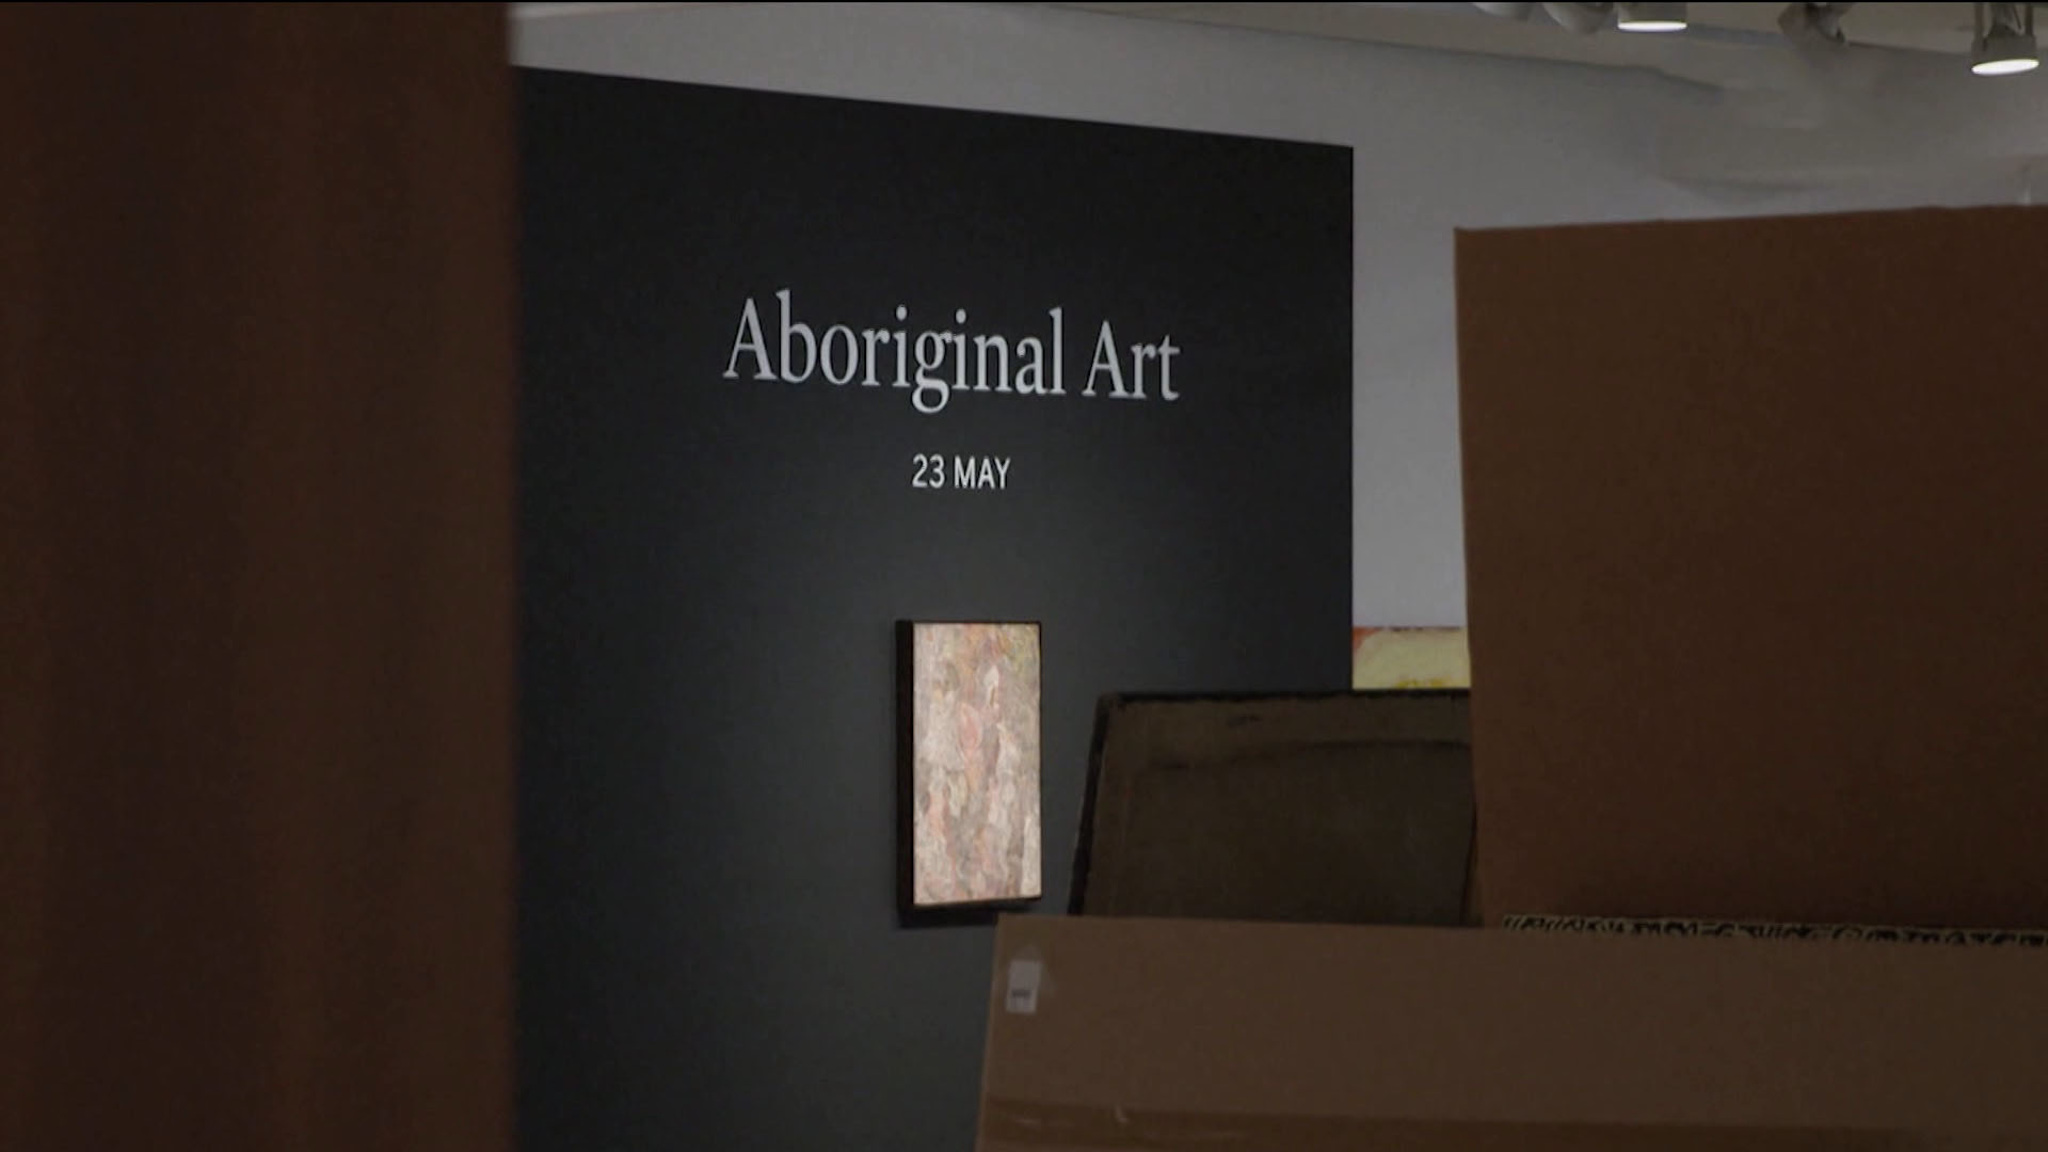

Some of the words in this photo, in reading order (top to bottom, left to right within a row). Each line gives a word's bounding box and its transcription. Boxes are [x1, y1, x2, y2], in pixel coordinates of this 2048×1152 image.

[723, 289, 1067, 414] Aboriginal
[1082, 320, 1181, 401] Art
[911, 452, 946, 490] 23
[953, 454, 1011, 491] MAY
